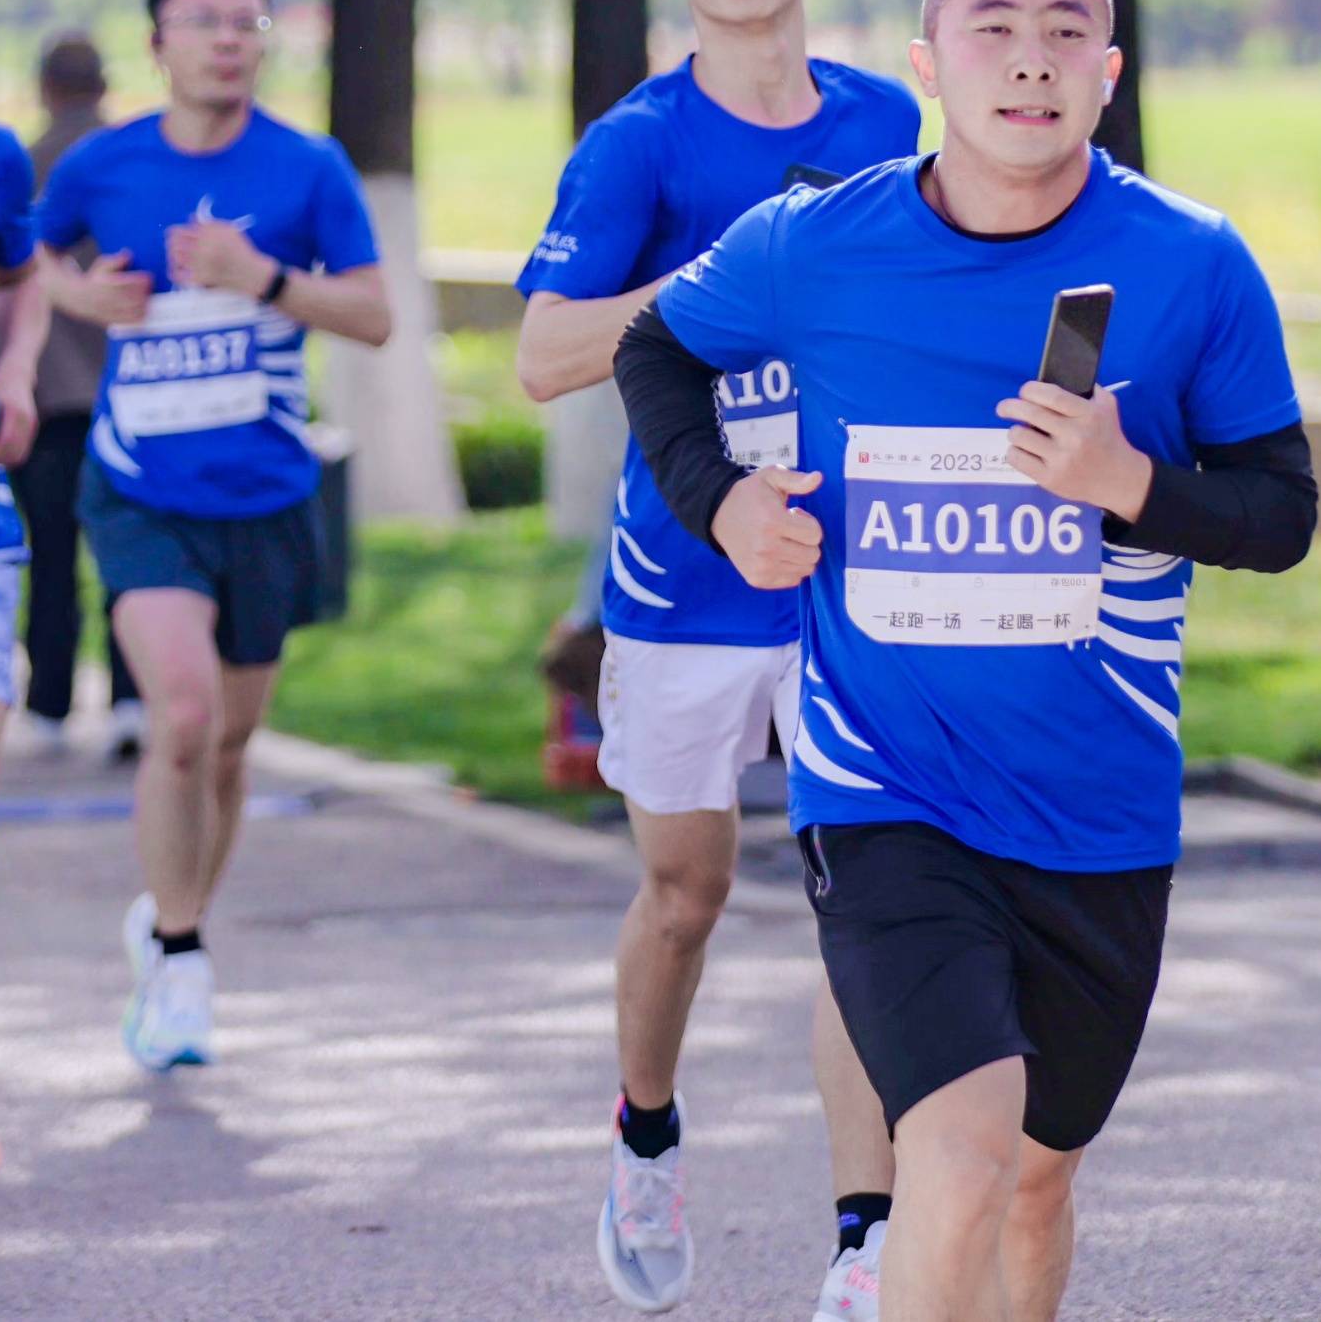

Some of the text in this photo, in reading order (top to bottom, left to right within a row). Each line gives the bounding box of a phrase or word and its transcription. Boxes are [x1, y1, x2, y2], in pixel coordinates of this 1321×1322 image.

[930, 453, 982, 471] 2023
[859, 500, 1083, 554] A10106
[872, 612, 1071, 630] 一起跑一场 一起喝一杯
